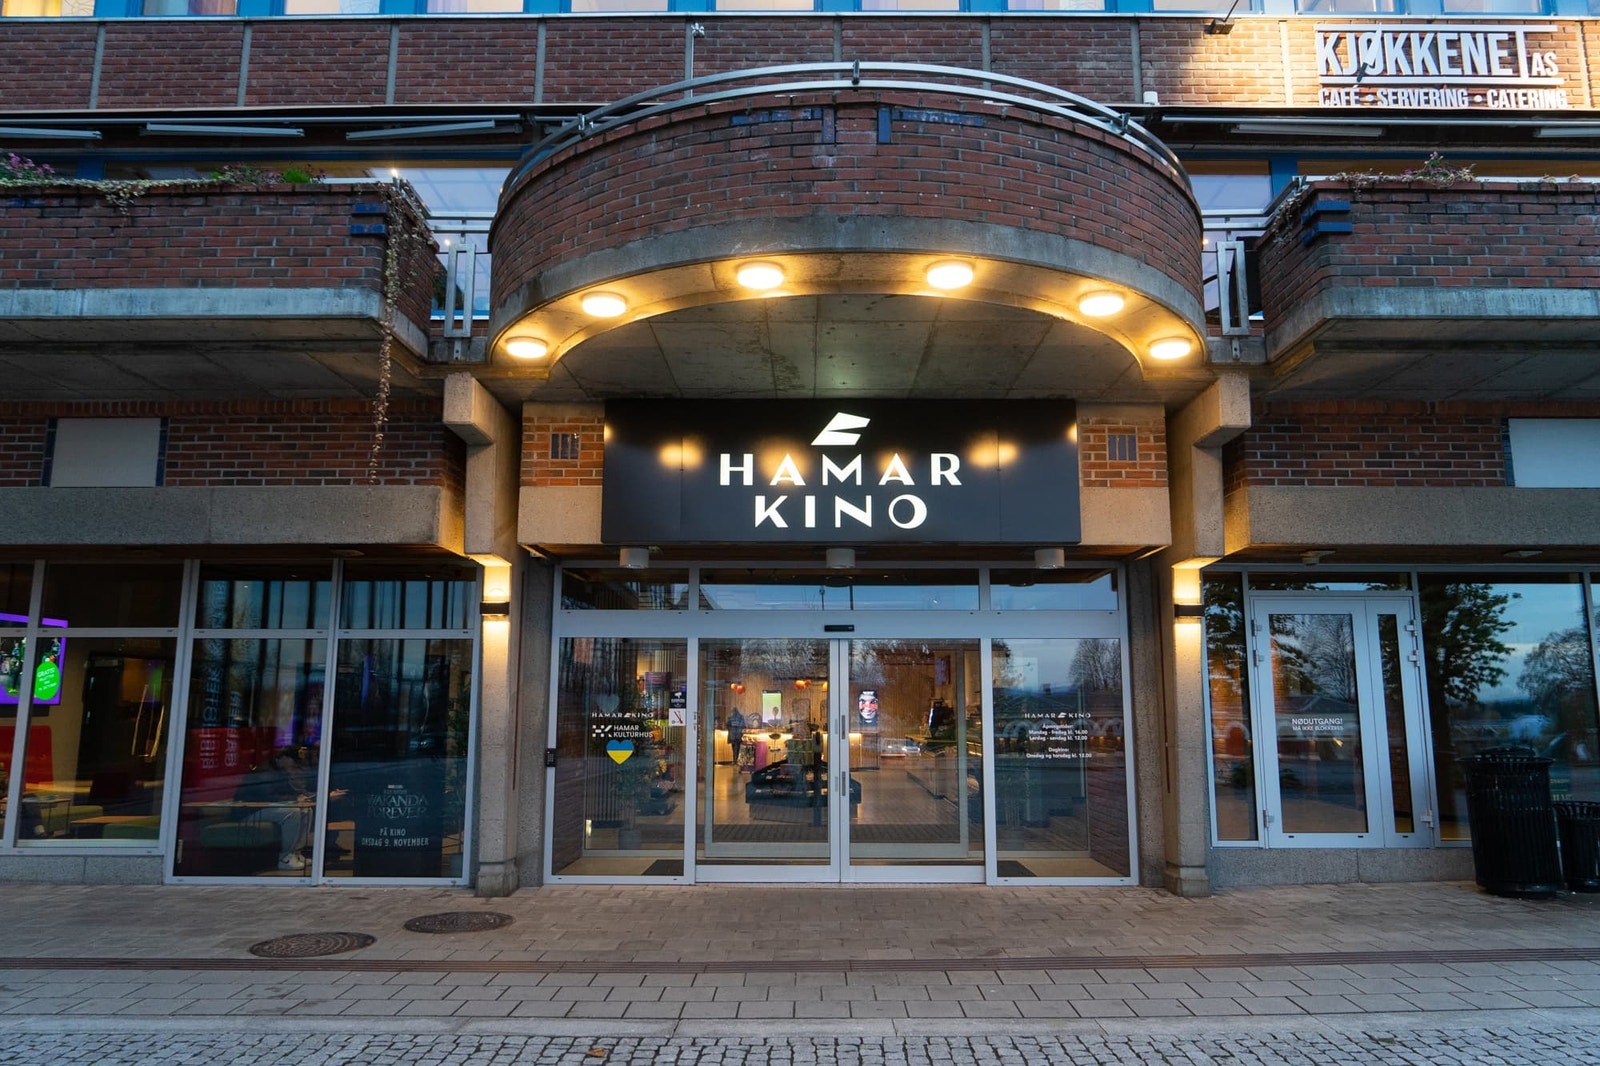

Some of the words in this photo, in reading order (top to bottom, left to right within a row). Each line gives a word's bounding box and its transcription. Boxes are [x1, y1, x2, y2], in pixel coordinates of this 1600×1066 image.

[1316, 24, 1530, 80] KJØKKENET
[1531, 52, 1559, 77] AS
[1319, 85, 1360, 107] CAFÉ
[1376, 88, 1469, 108] SERVERING
[1487, 89, 1568, 109] CATERING
[719, 453, 962, 486] HAMAR
[754, 494, 928, 529] KINO
[389, 828, 406, 836] KINO
[393, 837, 429, 847] NOVEMBER
